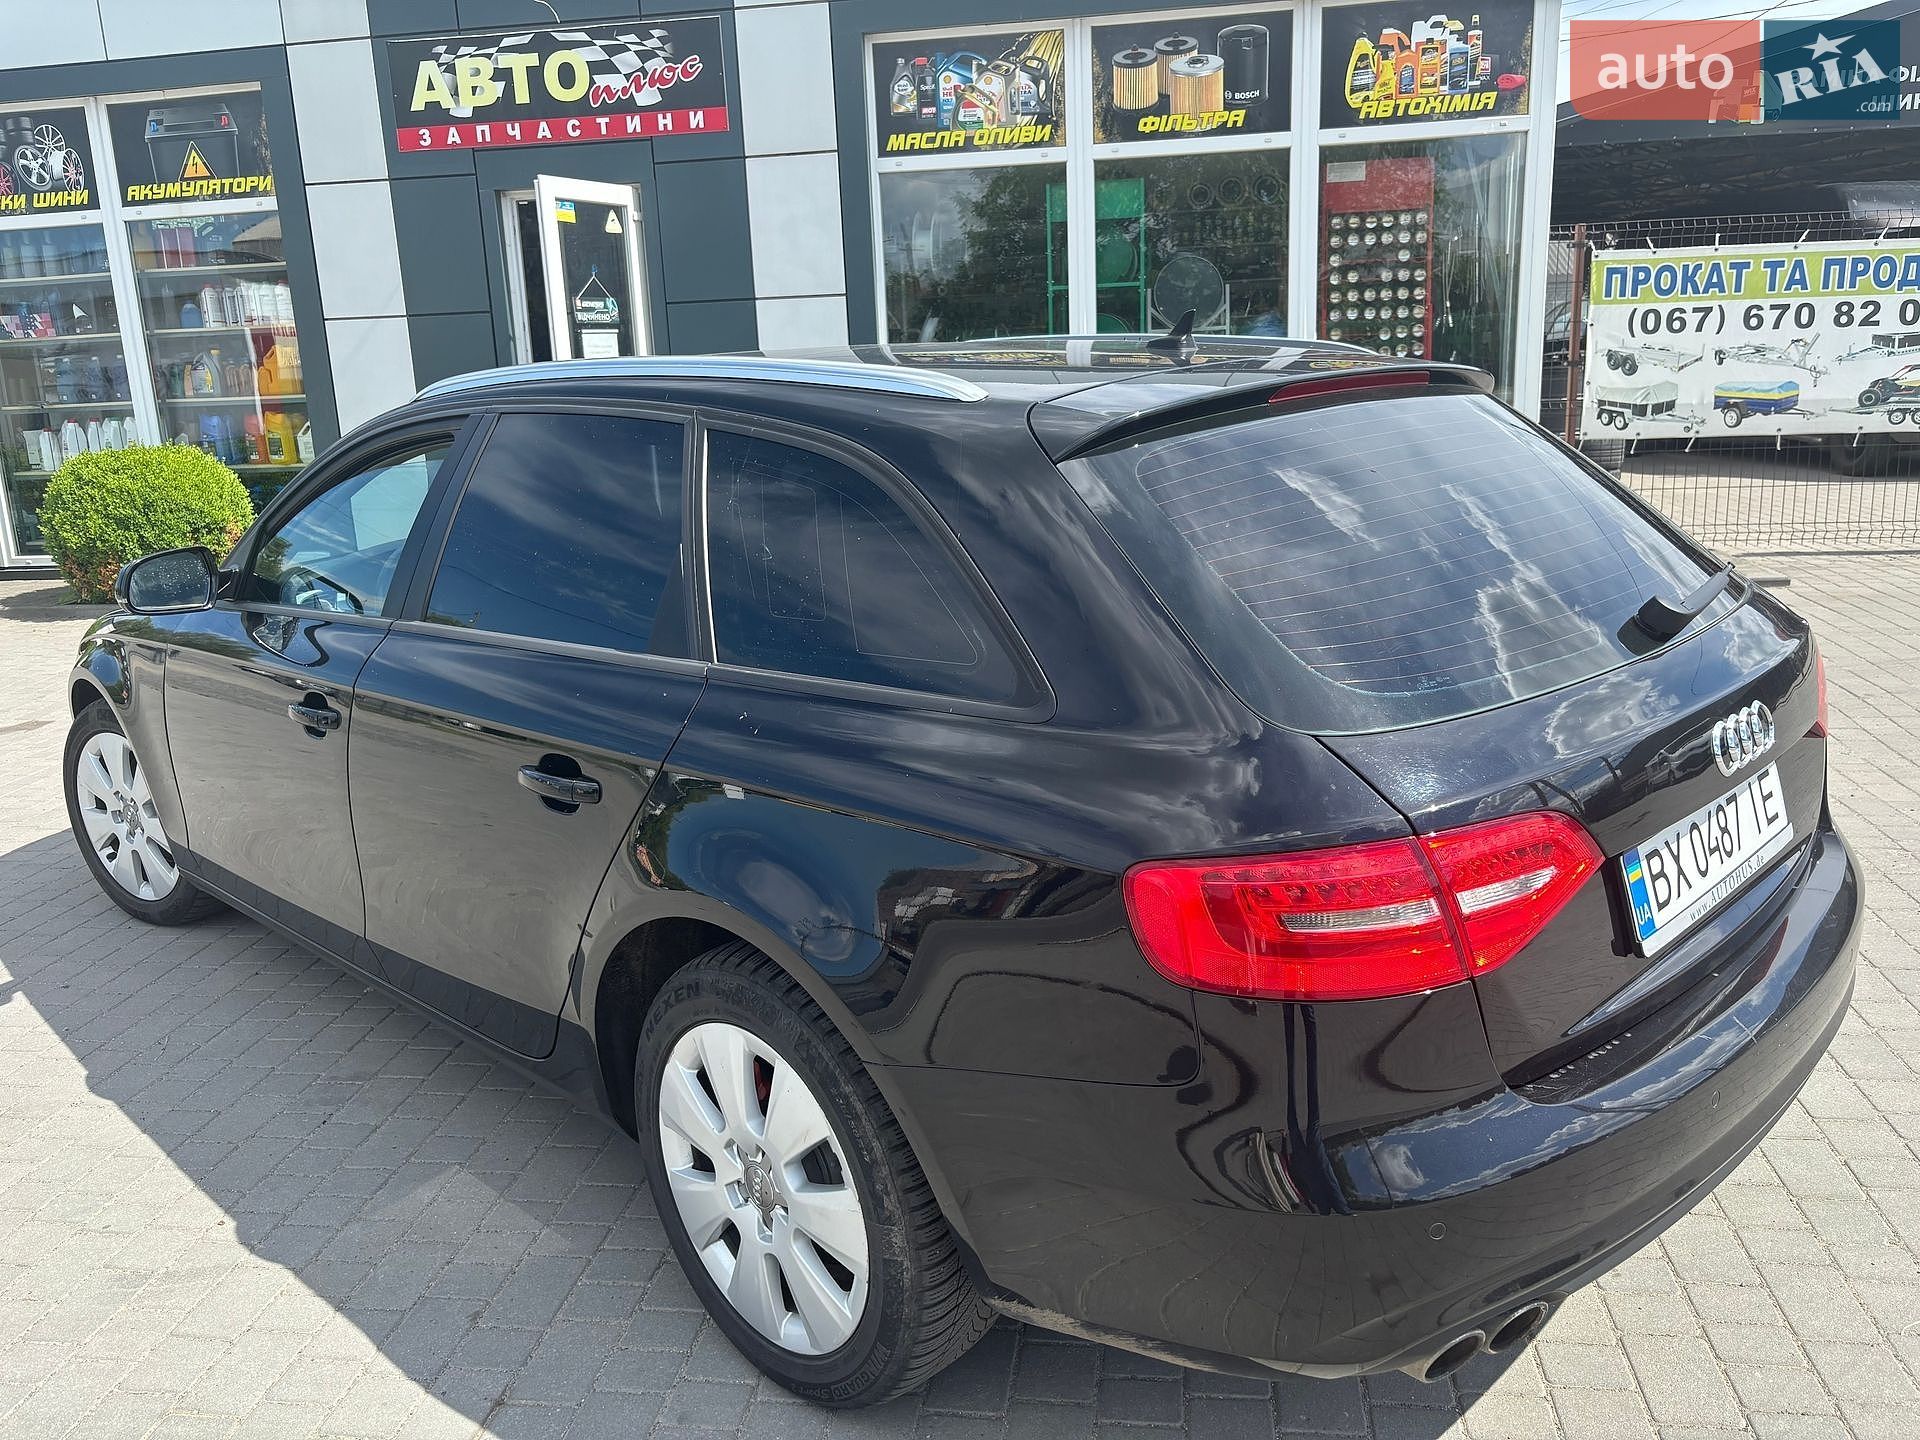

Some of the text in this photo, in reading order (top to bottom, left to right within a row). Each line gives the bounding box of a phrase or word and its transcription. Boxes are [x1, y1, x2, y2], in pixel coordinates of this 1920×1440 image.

[410, 49, 702, 112] АВТО плюс
[1234, 90, 1260, 100] BOSCH
[1137, 109, 1246, 134] ФІЛЬТРА
[1359, 91, 1498, 120] АВТОХІМІЯ
[418, 110, 706, 147] ЗАПЧАСТИНИ
[886, 124, 1053, 152] МАСЛА ОЛИВИ
[0, 189, 89, 210] КИ ШИНИ
[127, 175, 273, 202] АКУМУЛЯТОРИ
[1603, 261, 1751, 298] ПРОКАТ
[1762, 258, 1809, 293] ТА
[1627, 299, 1920, 338] (067) 670 82 0
[1645, 768, 1779, 913] BX 0487 IE
[1689, 854, 1766, 922] www.AUTOHUS.de
[1636, 902, 1652, 925] UA
[645, 981, 701, 1042] NEXEN
